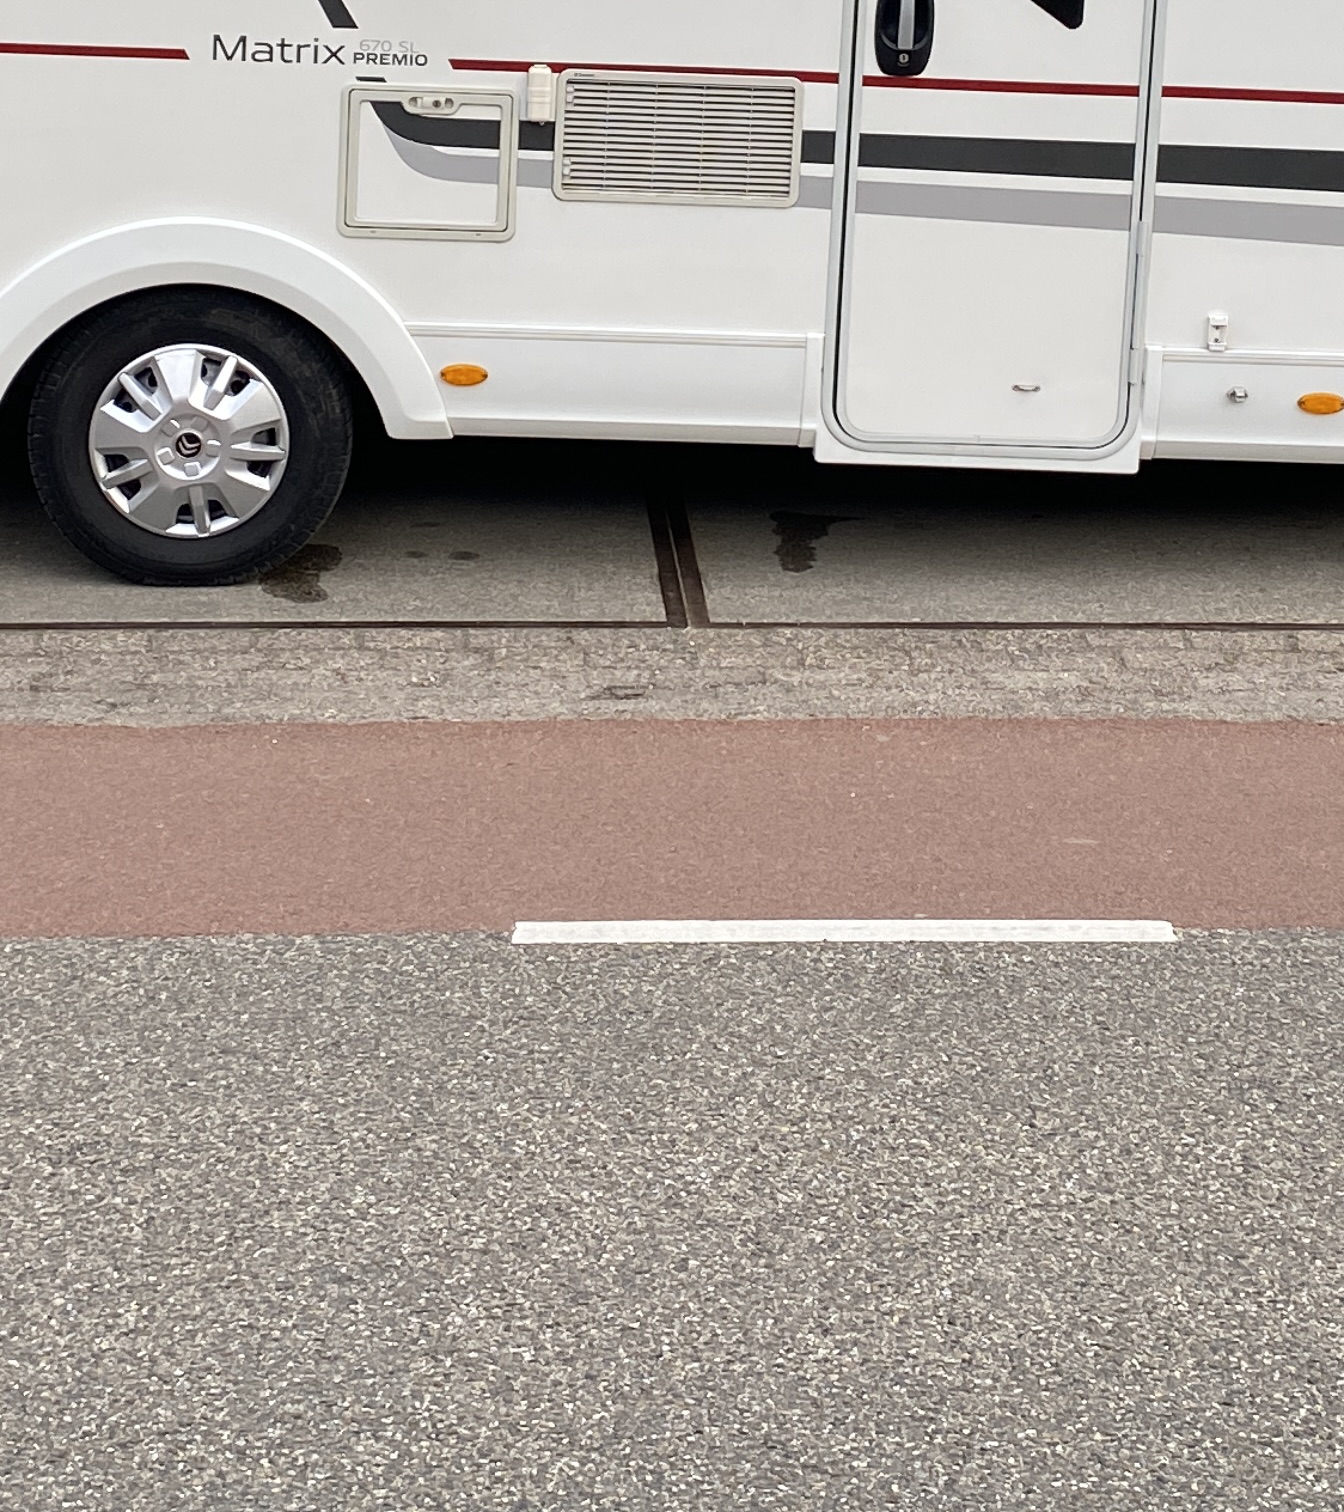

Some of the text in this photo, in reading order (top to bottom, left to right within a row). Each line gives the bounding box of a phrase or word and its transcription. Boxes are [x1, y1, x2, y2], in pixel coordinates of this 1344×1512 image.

[211, 33, 346, 66] Matrix
[359, 39, 420, 55] 670 SL
[352, 52, 429, 67] PREMIO
